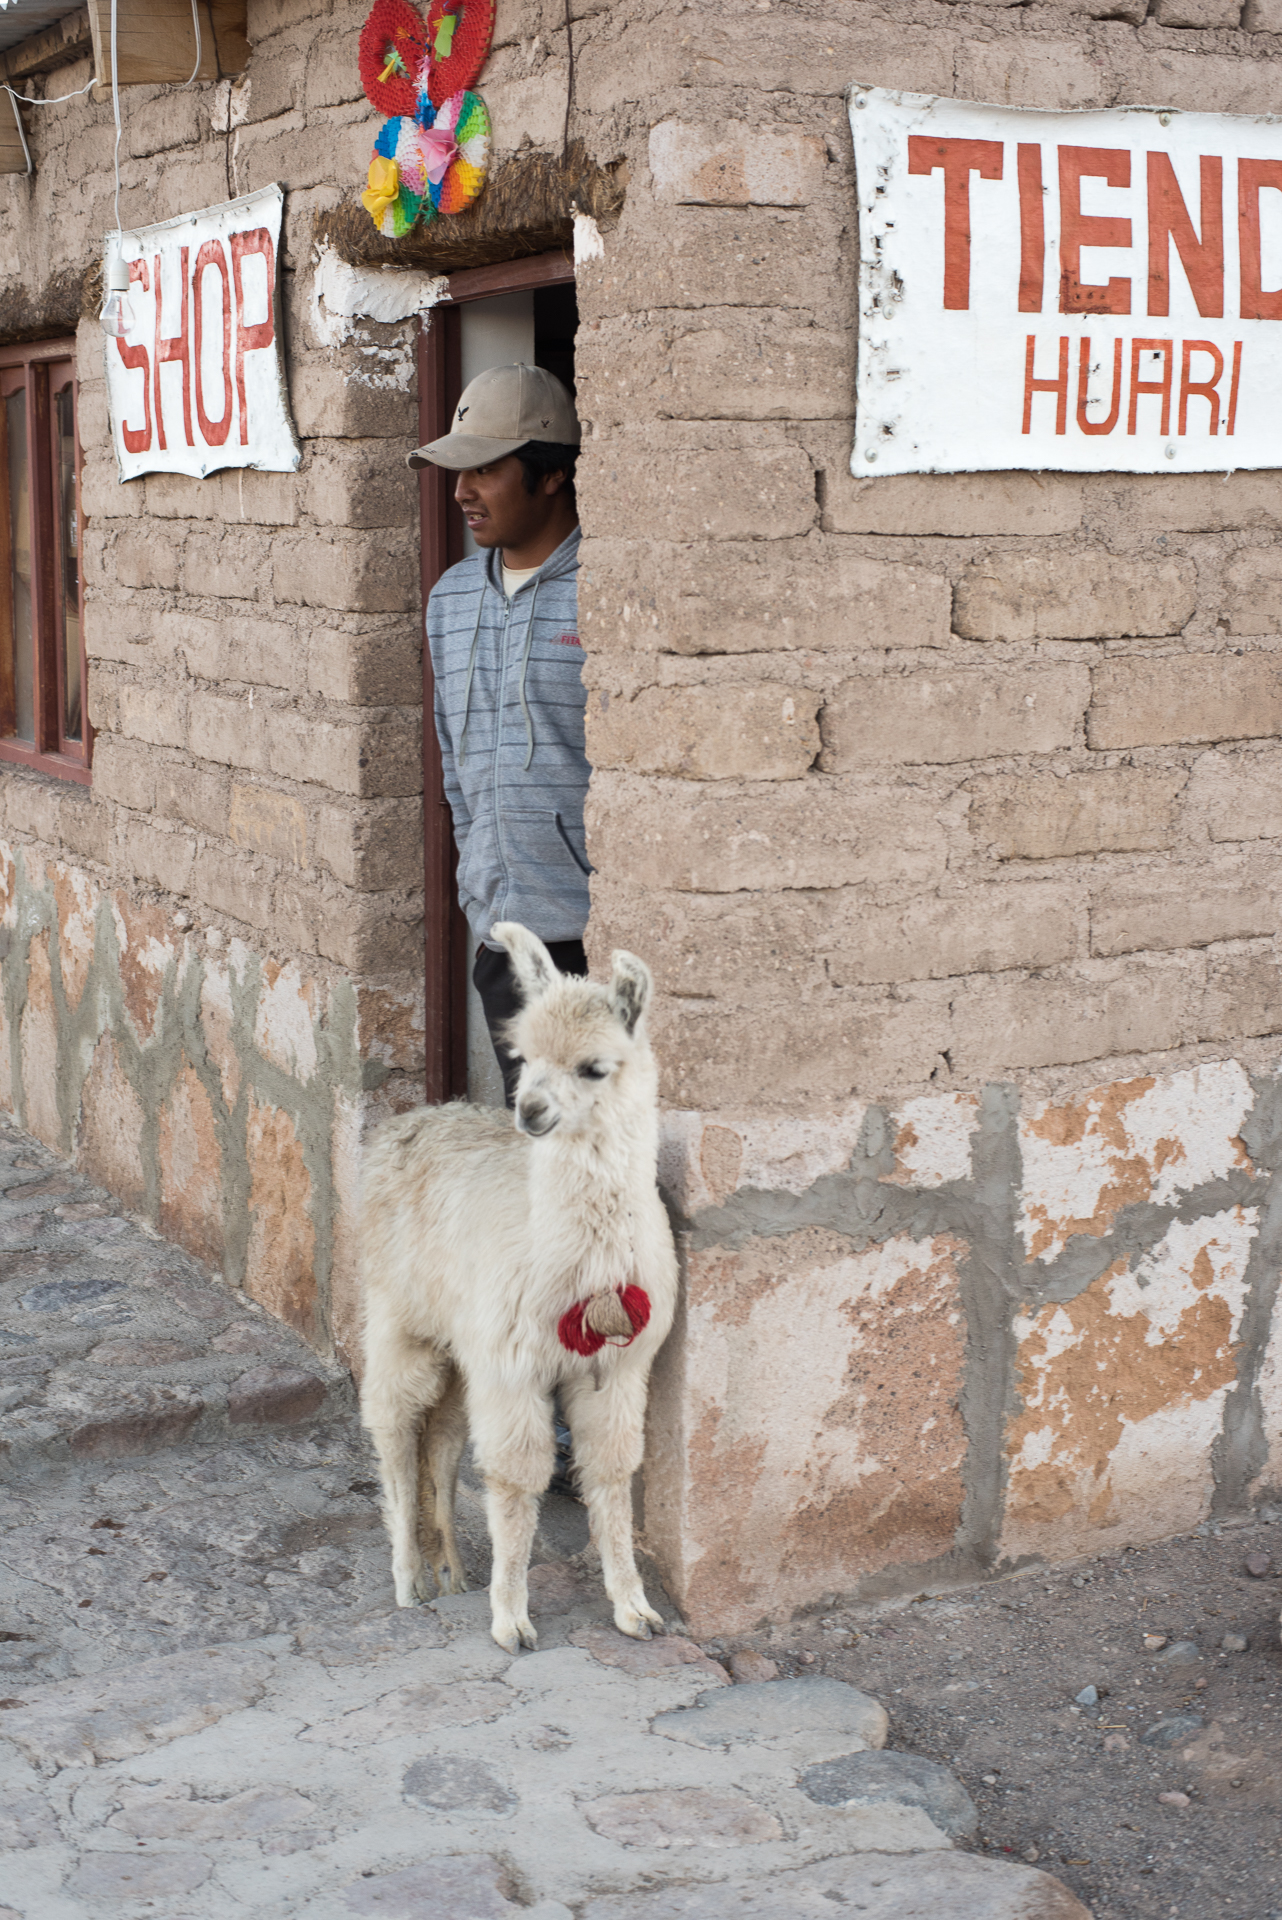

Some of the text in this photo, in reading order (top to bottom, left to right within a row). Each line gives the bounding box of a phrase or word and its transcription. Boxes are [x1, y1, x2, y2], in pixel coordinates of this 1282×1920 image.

[908, 135, 1282, 321] TIEND
[116, 226, 275, 454] SHOP
[1021, 335, 1243, 436] HUARI
